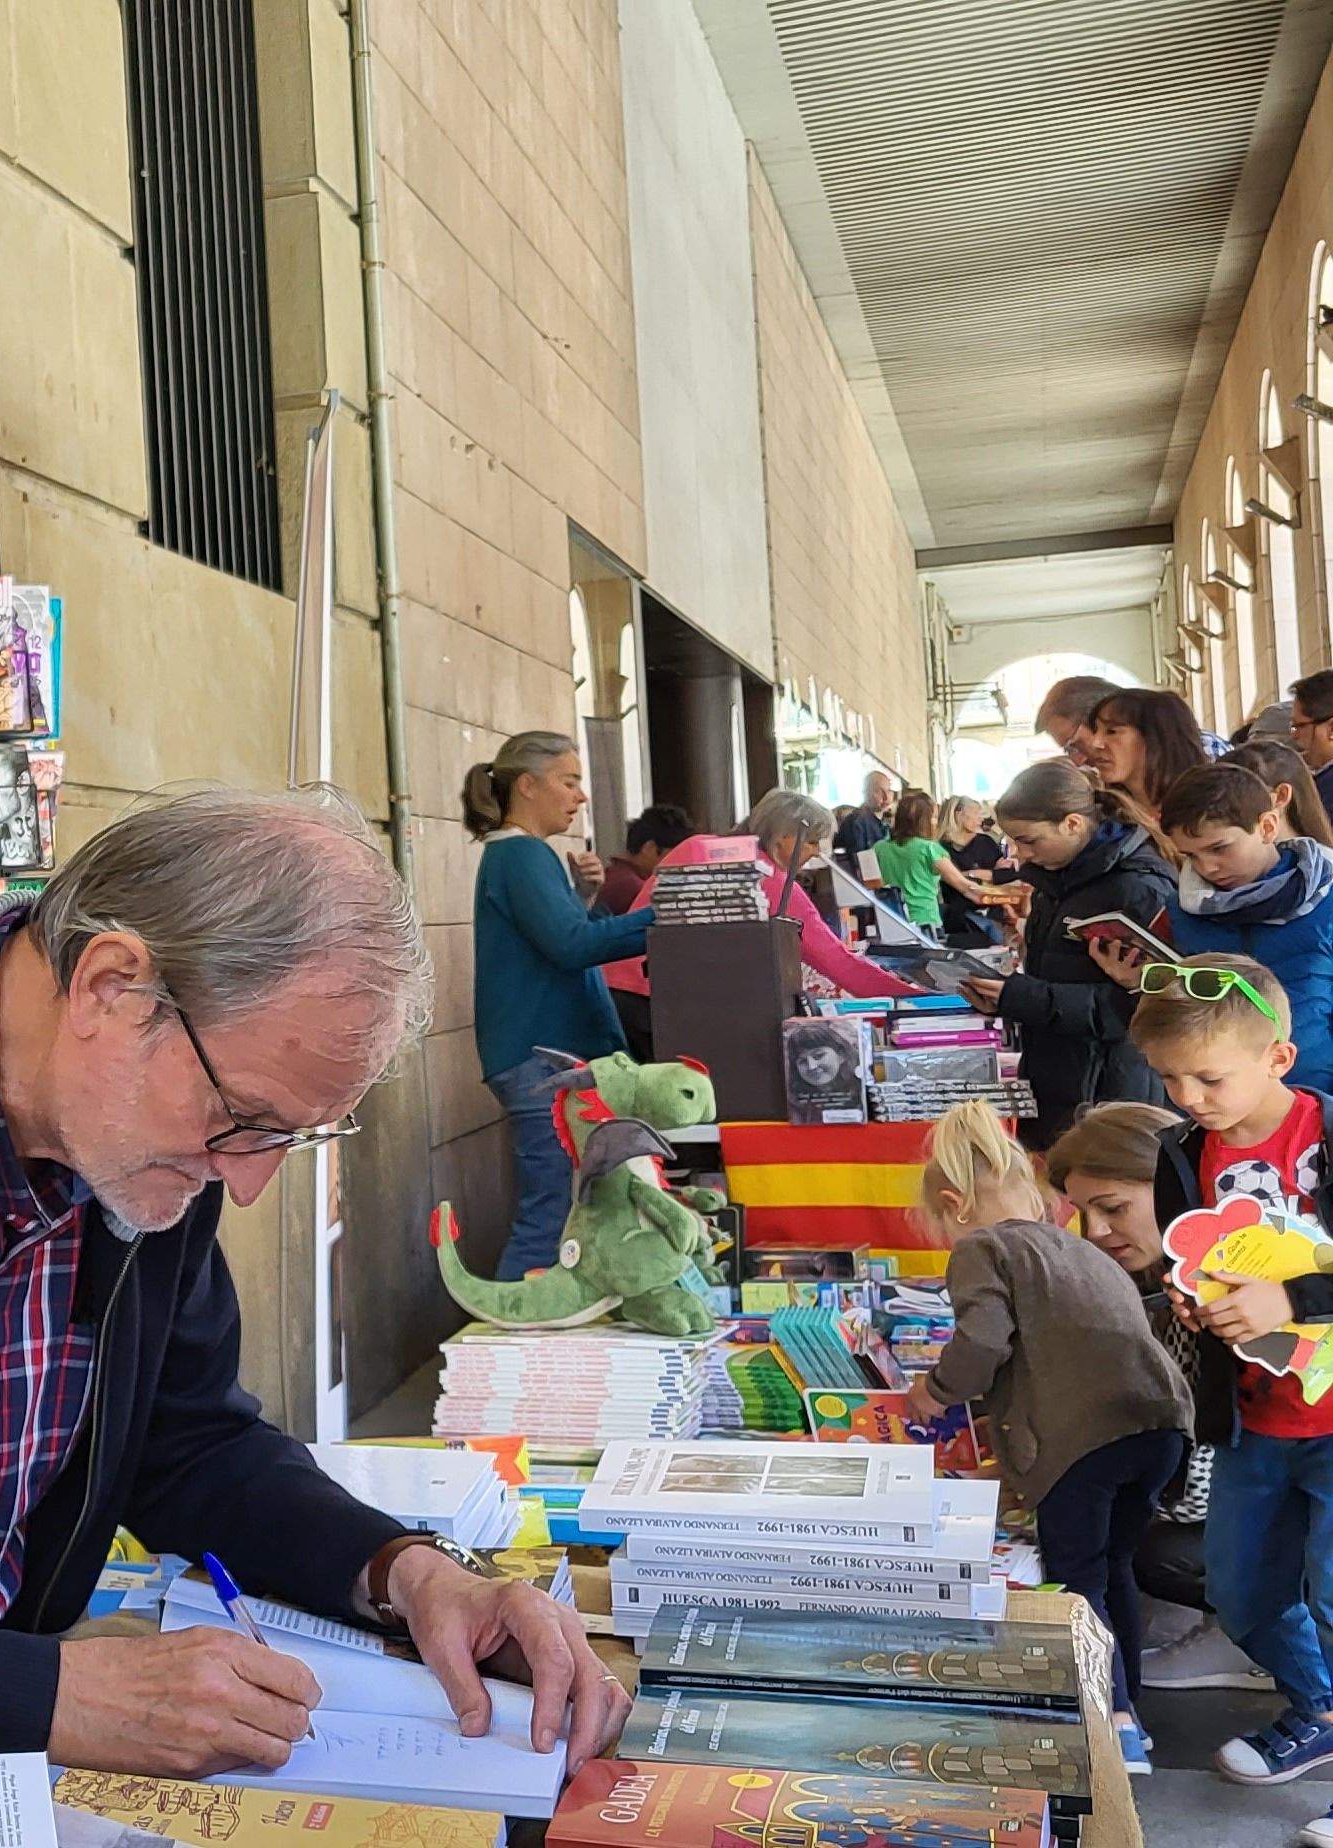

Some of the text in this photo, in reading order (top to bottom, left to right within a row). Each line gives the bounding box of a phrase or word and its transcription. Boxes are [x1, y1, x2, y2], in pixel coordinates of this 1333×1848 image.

[873, 1404, 892, 1443] AGICA
[606, 1516, 878, 1537] HUESCA 1981-1992 FERNANDO ALVIRA LIZANO
[654, 1545, 933, 1573] HUESCA 1981-1992 FERNANDO ALVIRA LIZANO
[636, 1567, 914, 1594] HUESCA 1981-1992 FERNANDO ALVIRA LIZANO
[599, 1774, 659, 1824] GADEA
